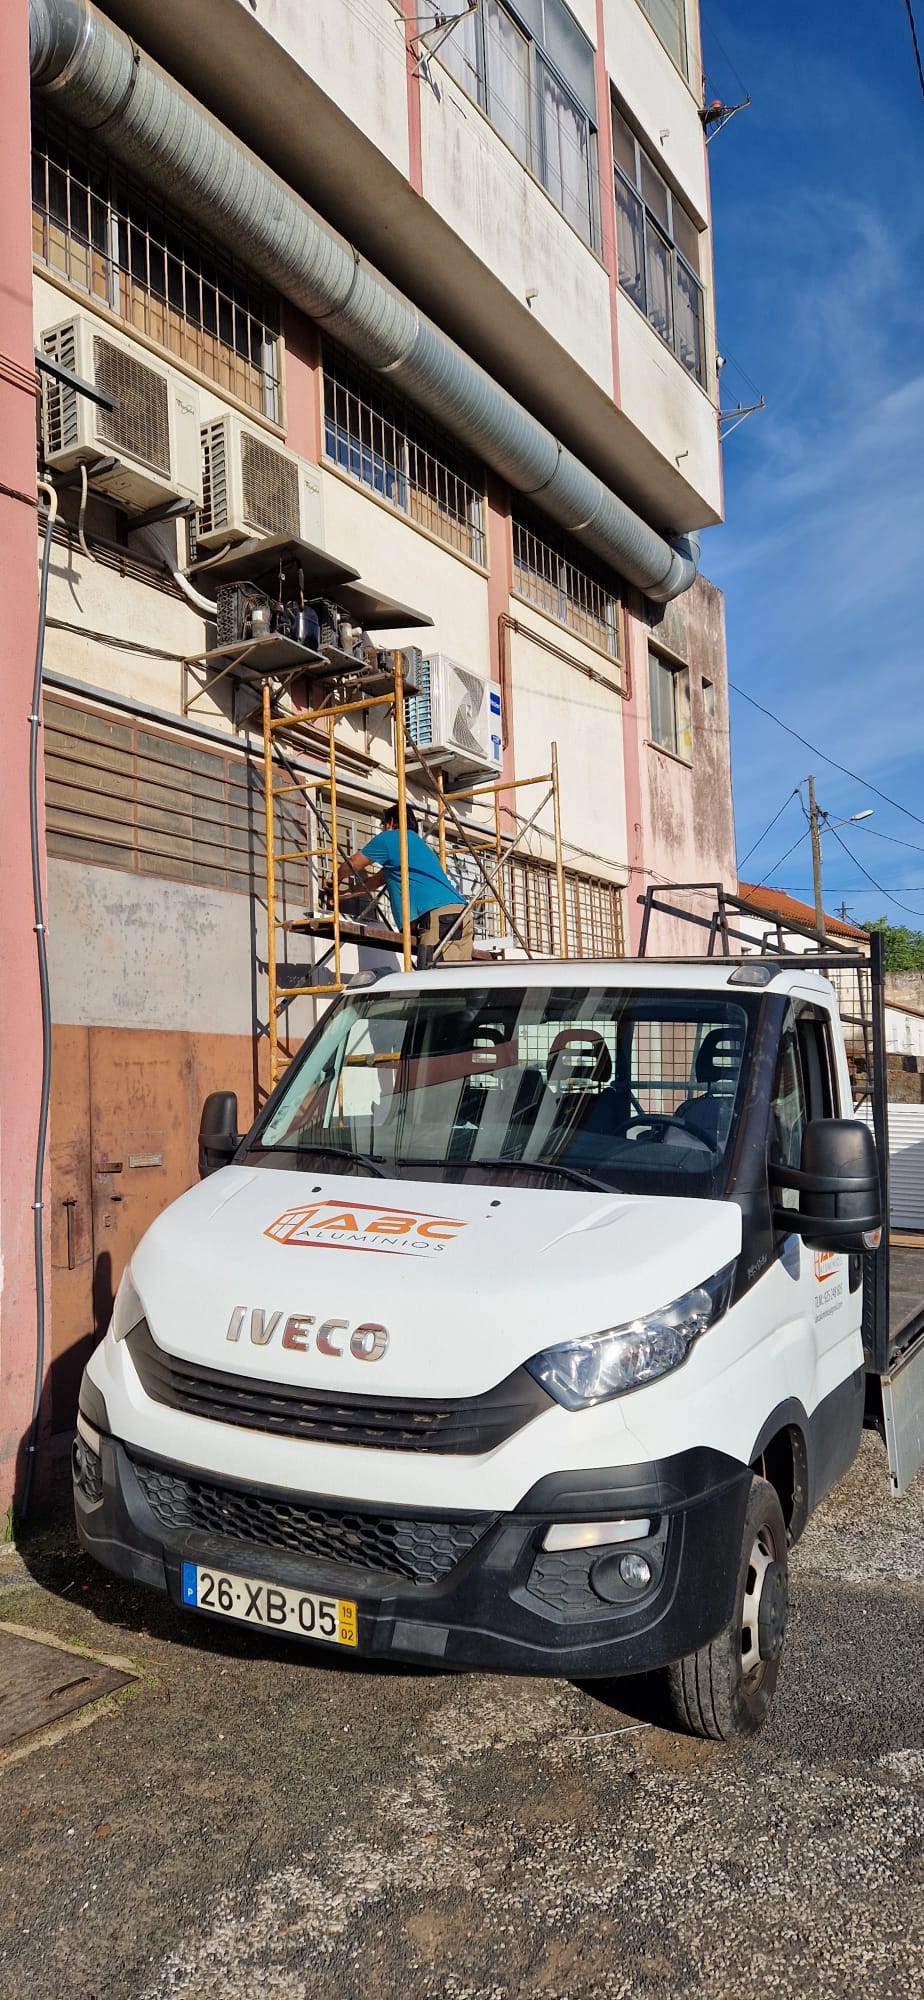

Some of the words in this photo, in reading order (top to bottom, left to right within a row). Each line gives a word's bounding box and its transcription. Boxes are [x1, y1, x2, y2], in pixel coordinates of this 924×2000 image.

[307, 1213, 469, 1239] ABC
[225, 1306, 391, 1363] IVECO
[187, 1588, 194, 1597] P
[342, 1606, 353, 1619] 19
[341, 1628, 354, 1642] 02
